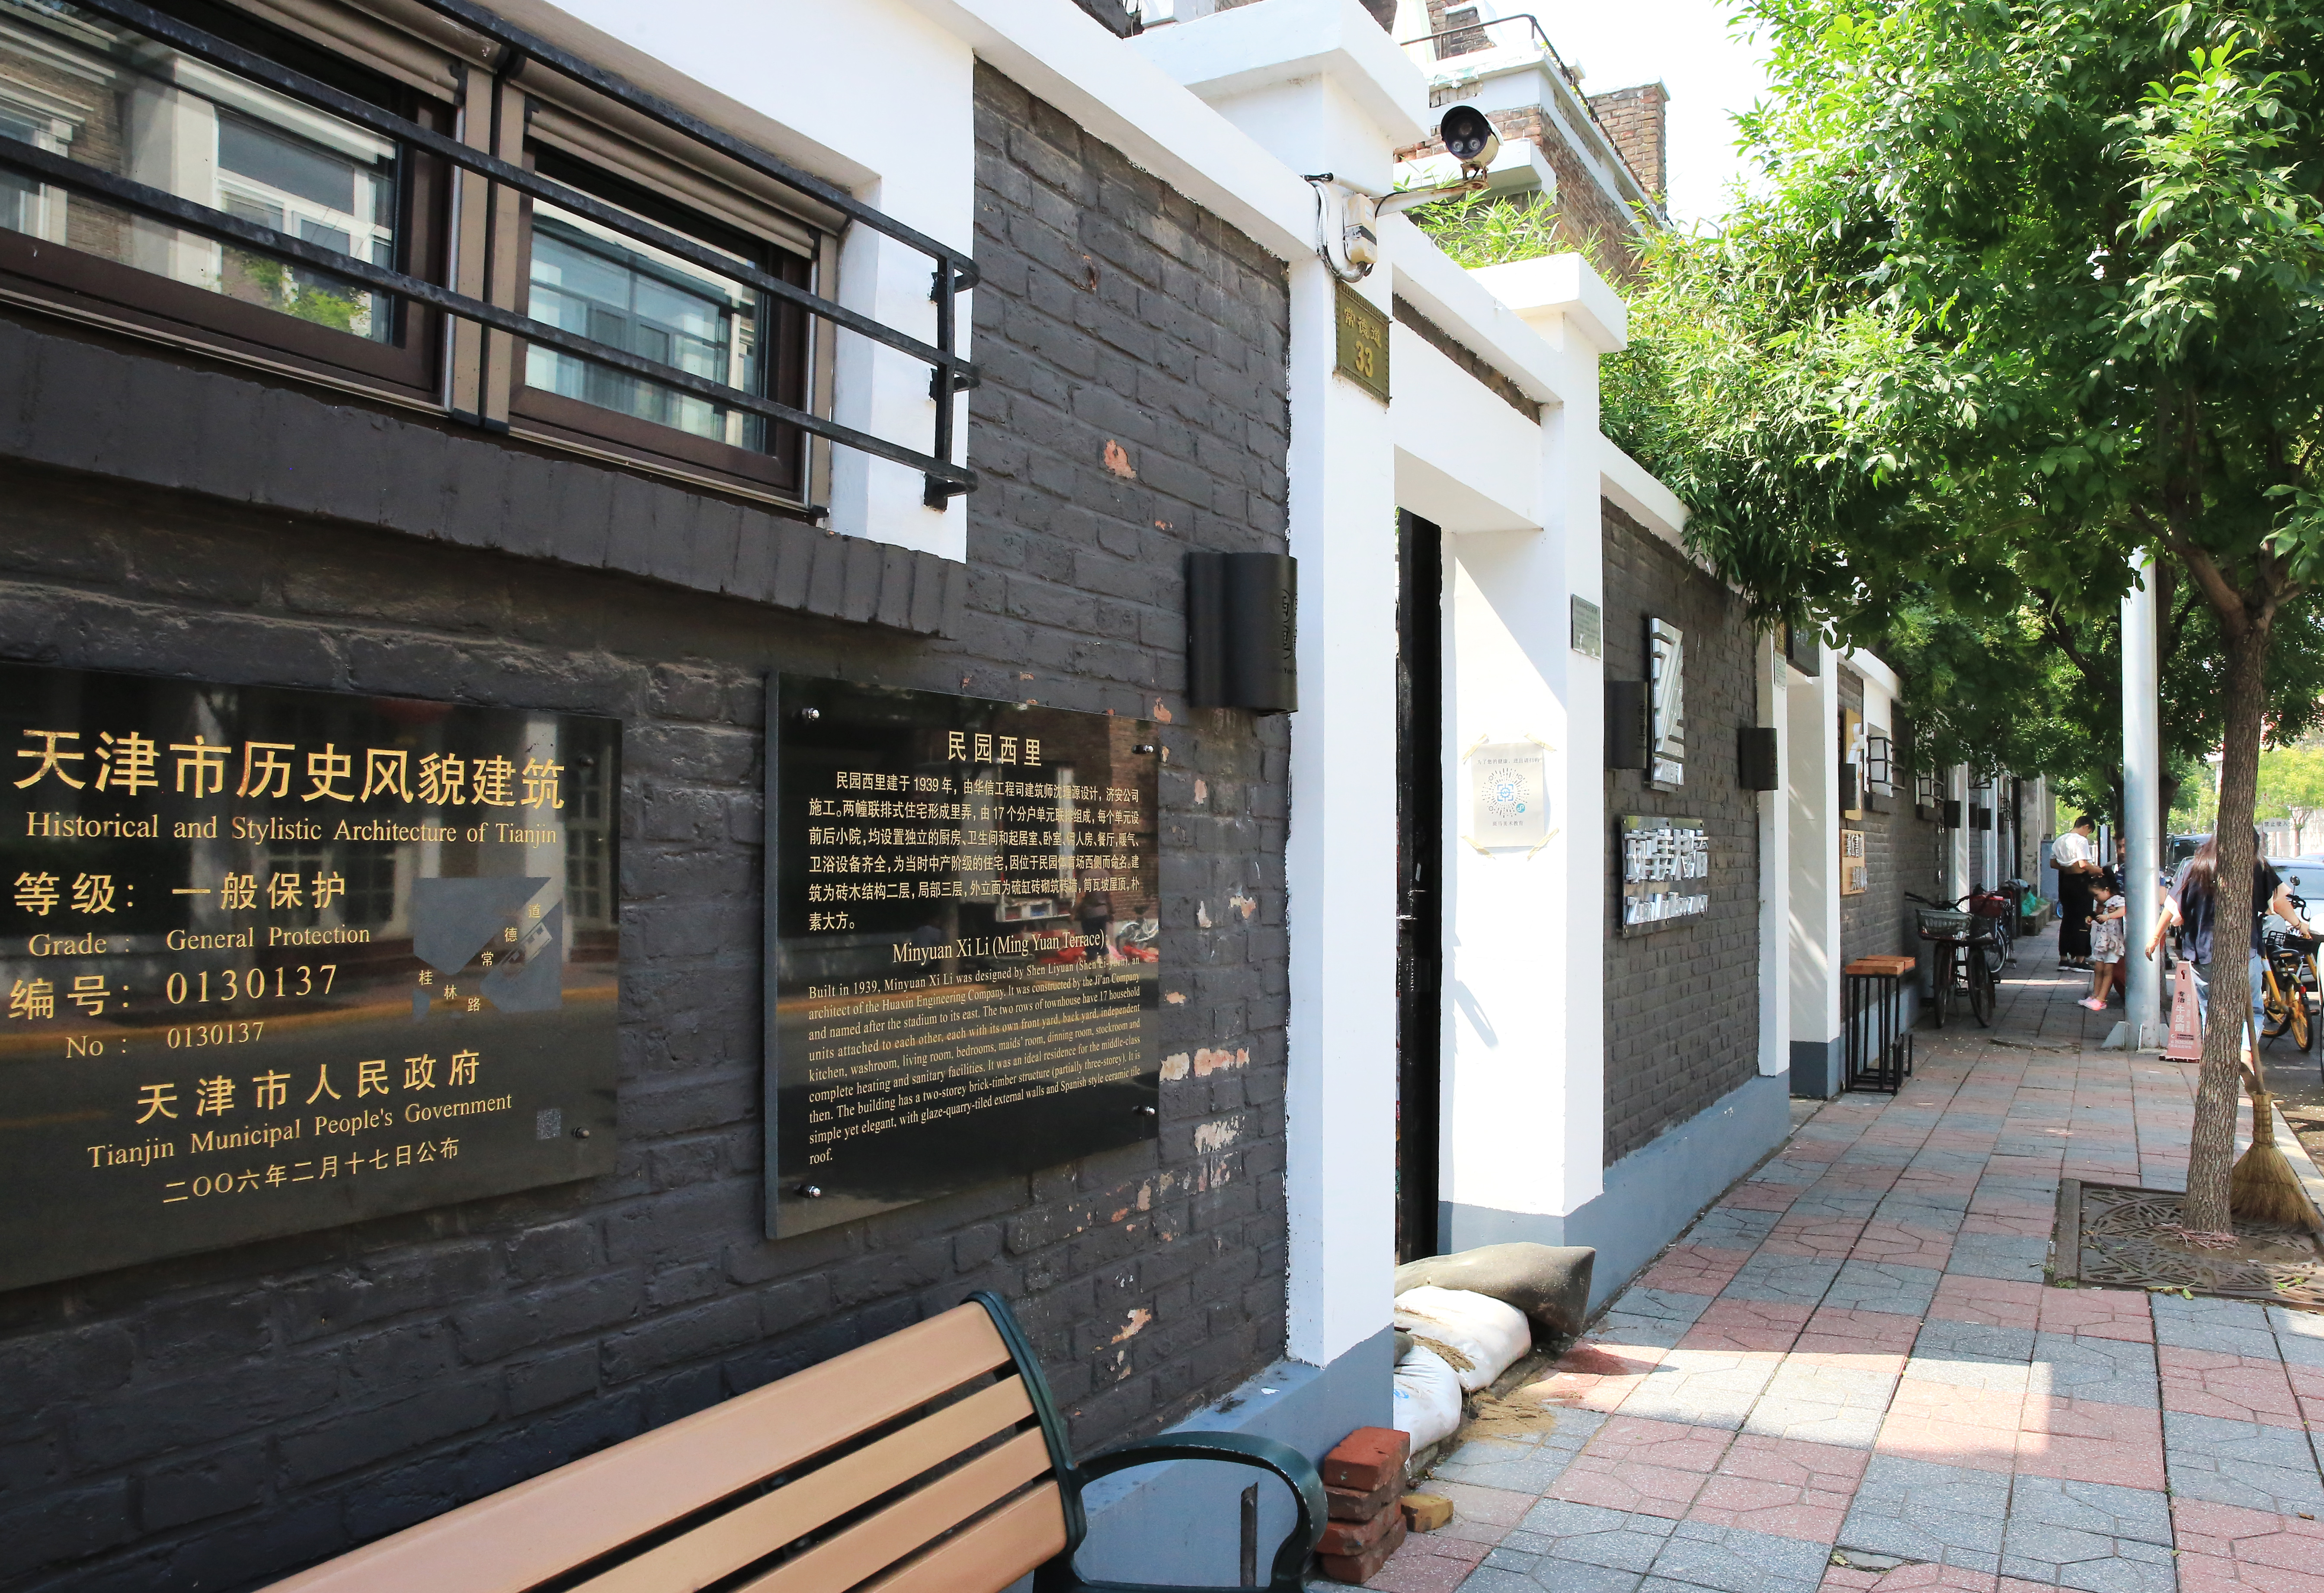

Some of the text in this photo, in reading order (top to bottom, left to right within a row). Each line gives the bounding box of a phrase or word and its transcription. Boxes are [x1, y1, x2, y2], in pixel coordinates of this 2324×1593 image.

[1344, 306, 1382, 349] 常德道
[1355, 341, 1373, 378] 33
[13, 729, 564, 810] 天津市历史风貌建筑
[948, 731, 1042, 766] 民园西里
[26, 811, 557, 849] Historical and Stylistic Architecture of Tianjin
[172, 871, 345, 910] 一般保护
[166, 926, 255, 951] General
[268, 924, 371, 946] Protection
[481, 904, 541, 967] 常德道
[809, 911, 855, 931] 素大方。
[893, 929, 1105, 966] Minyuan Xi Li (Ming Yuan Terrace)
[166, 964, 337, 1004] 0130137
[419, 970, 481, 1012] 桂林路
[808, 984, 835, 999] Built
[839, 983, 849, 996] in
[854, 980, 880, 994] 1939,
[884, 978, 925, 993] Minyuan
[928, 973, 940, 986] Xi
[943, 972, 953, 985] Li
[955, 974, 972, 984] was
[975, 966, 1012, 983] designed
[1014, 966, 1024, 980] by
[1026, 964, 1045, 976] Shen
[1048, 962, 1073, 976] Liyuan
[1132, 957, 1140, 965] an
[808, 973, 1139, 1020] architect of the Huaxin Engineering Company. It was constructed by the Ji’an Company
[808, 985, 1140, 1041] and named after the stadium to its east. The two rows of townhouse have 17 household
[809, 1046, 834, 1061] units
[838, 1039, 879, 1057] attached
[882, 1039, 891, 1050] to
[894, 1034, 915, 1048] each
[946, 1026, 966, 1041] each
[968, 1023, 986, 1037] with
[989, 1022, 999, 1034] its
[1002, 1022, 1018, 1032] own
[1021, 1017, 1040, 1029] front
[1062, 1010, 1079, 1023] back
[1101, 1003, 1140, 1018] independent
[166, 1021, 264, 1049] 0130137
[809, 1017, 1140, 1082] kitchen, washroom, living room, bedrooms, maids’ room, dinning room, stockroom and
[136, 1048, 480, 1125] 天津市人民政府
[809, 1035, 1140, 1103] complete heating and sanitary facilities. It was an ideal residence for the middle-class
[809, 1049, 1140, 1123] then. The building has a two-storey brick-timber structure (partially three-storey). It is
[809, 1065, 1140, 1144] simple yet elegant, with glaze-quarry-tiled external walls and Spanish style ceramic tile
[87, 1093, 512, 1167] Tianjin Municipal People's Government
[809, 1147, 832, 1165] roof.
